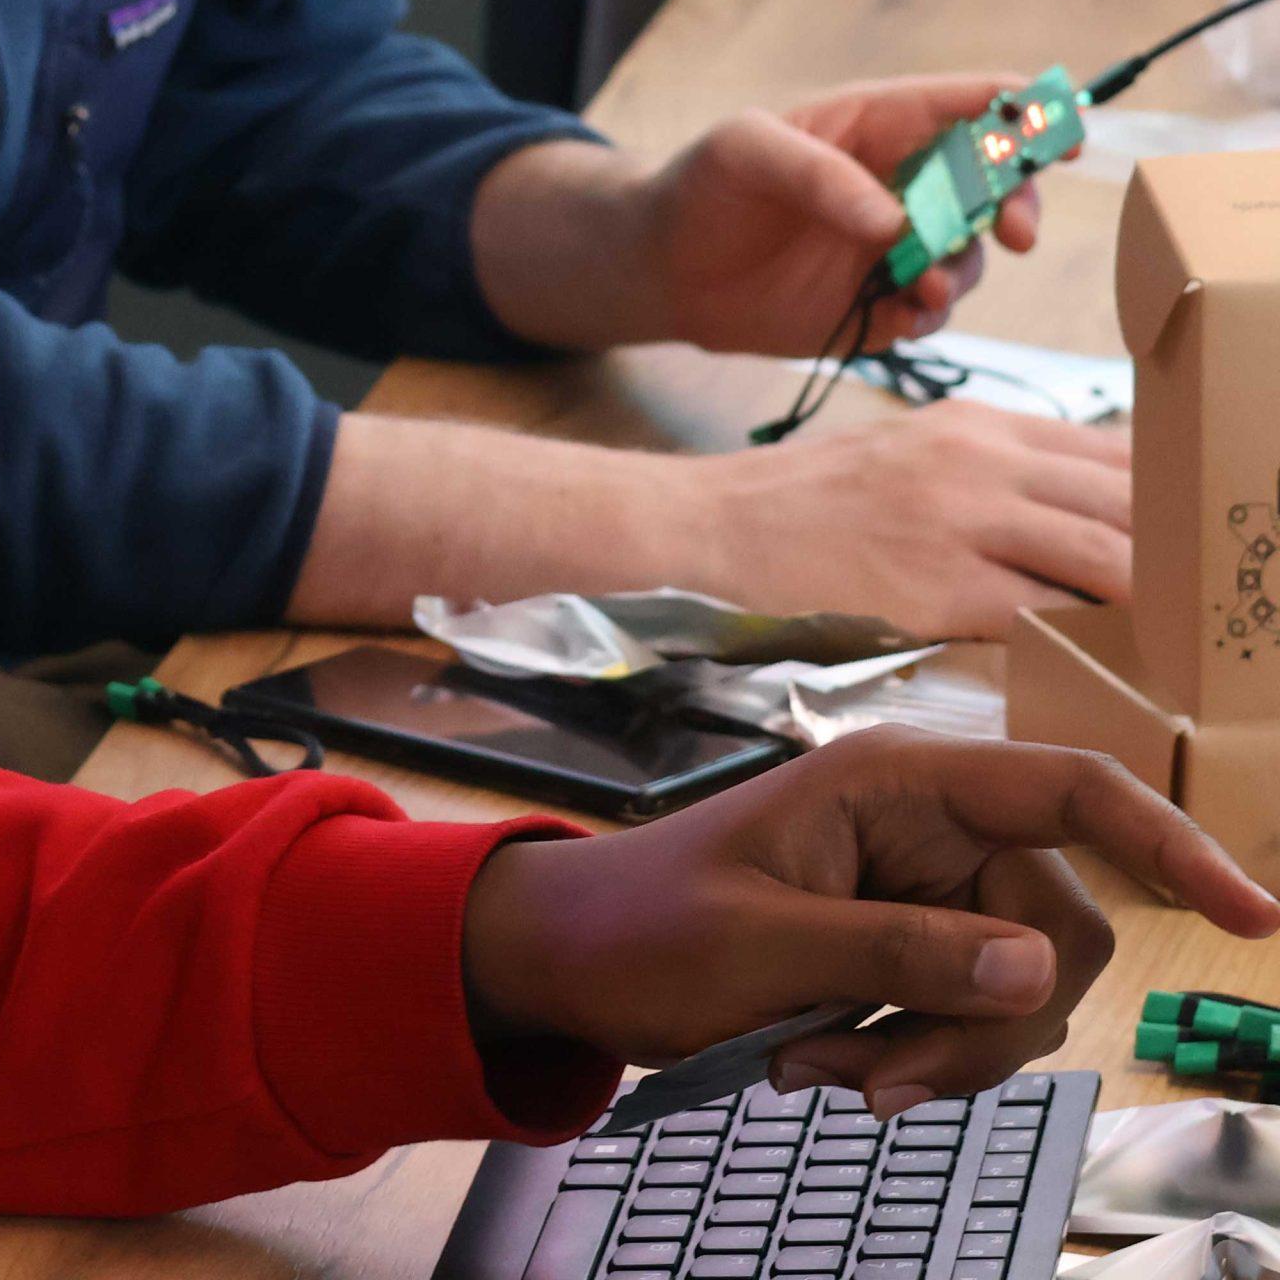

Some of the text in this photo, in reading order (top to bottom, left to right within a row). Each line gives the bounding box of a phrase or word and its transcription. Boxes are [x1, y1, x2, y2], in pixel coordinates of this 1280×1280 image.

[690, 1137, 712, 1145] Z
[849, 1141, 870, 1150] W
[765, 1148, 787, 1156] S
[680, 1163, 702, 1171] X
[757, 1174, 778, 1182] D
[671, 1189, 692, 1198] C
[881, 1206, 903, 1214] 5
[649, 1243, 672, 1252] B
[867, 1262, 886, 1270] 7
